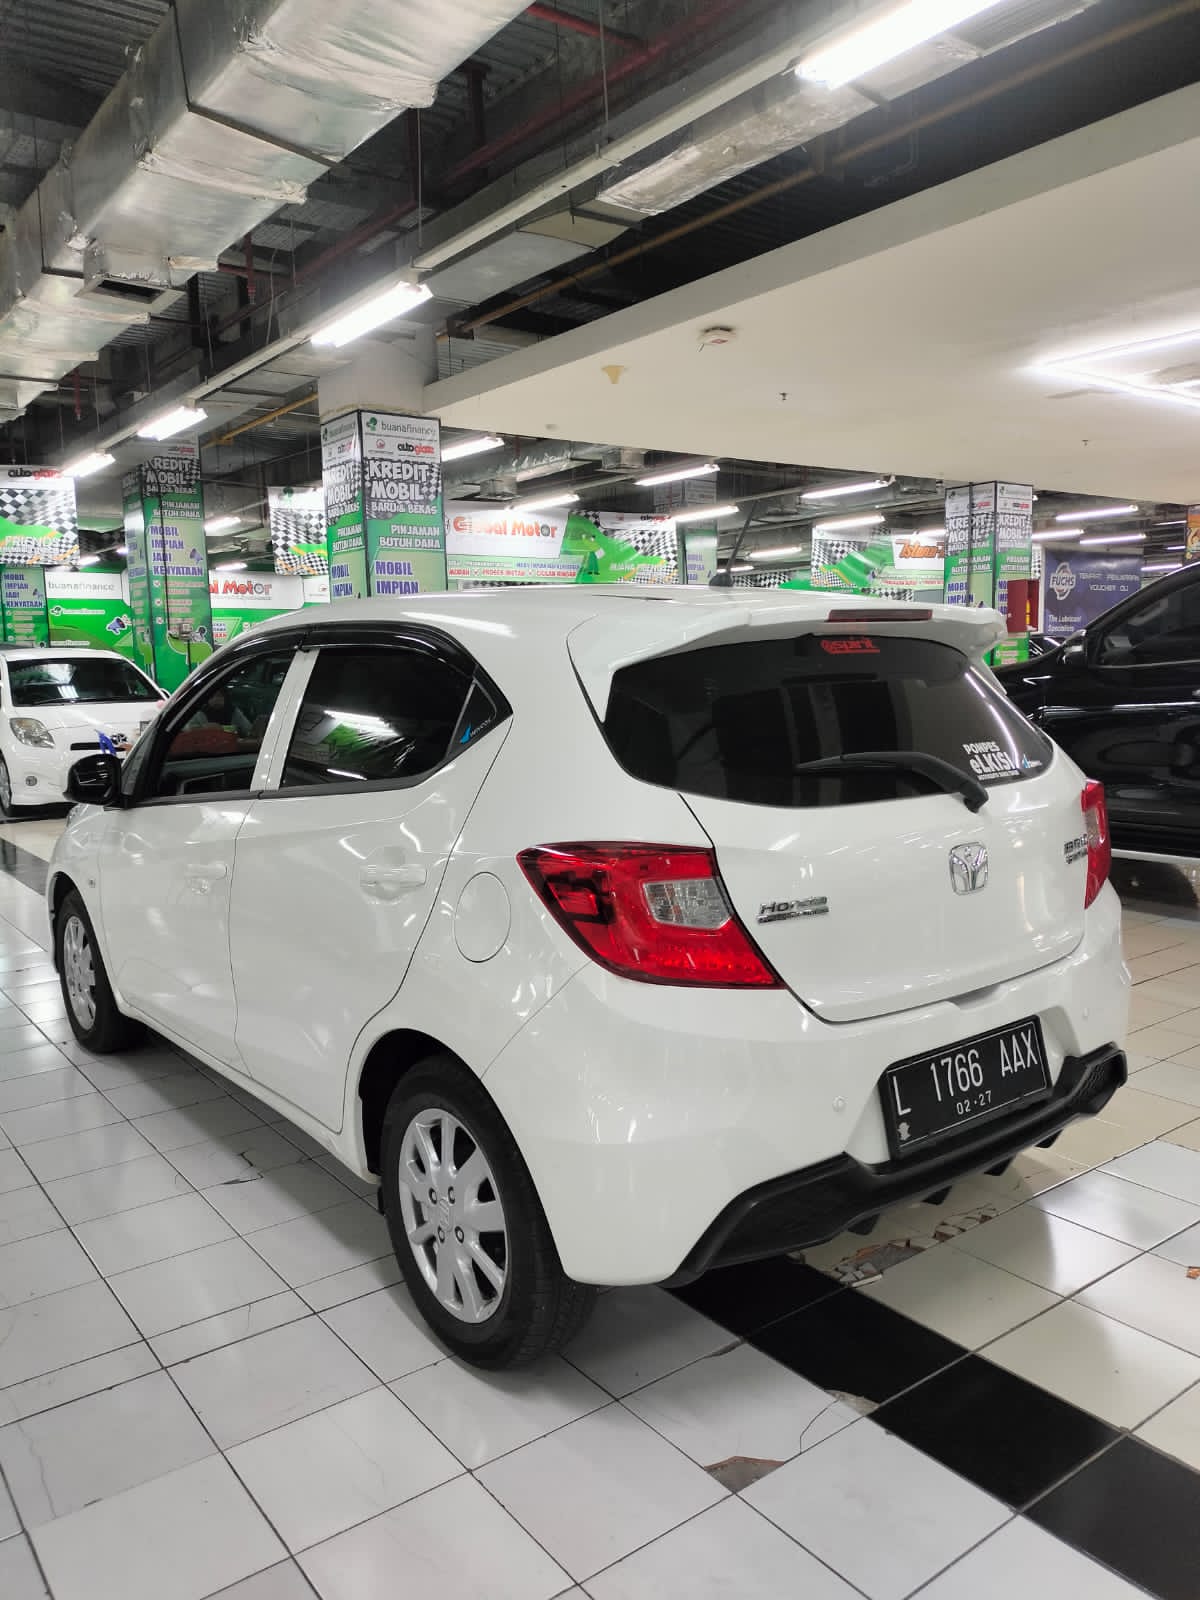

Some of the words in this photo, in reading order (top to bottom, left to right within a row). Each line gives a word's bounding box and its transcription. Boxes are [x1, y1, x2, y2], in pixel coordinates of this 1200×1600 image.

[146, 470, 187, 485] MOBIL
[369, 461, 429, 481] KREDIT
[327, 482, 353, 505] MOBIL
[371, 480, 425, 500] MOBIL
[371, 501, 397, 512] BARU
[407, 504, 437, 514] BEKAS
[150, 525, 179, 536] MOBIL
[390, 524, 440, 536] PINJAMAN
[152, 539, 184, 549] IMPIAN
[379, 536, 412, 547] BUTUH
[414, 539, 441, 549] DANA
[153, 552, 172, 561] JADI
[153, 565, 203, 576] KENYATAAN
[331, 564, 350, 579] MOBIL
[375, 561, 414, 575] MOBIL
[48, 582, 115, 591] buanafinance
[376, 580, 419, 594] IMPIAN
[1050, 574, 1076, 587] FUCHS
[332, 583, 353, 597] IMPIAN
[6, 600, 43, 608] KENYATAAN
[893, 1075, 911, 1116] L
[930, 1049, 983, 1102] 1766
[1000, 1029, 1038, 1077] AAX
